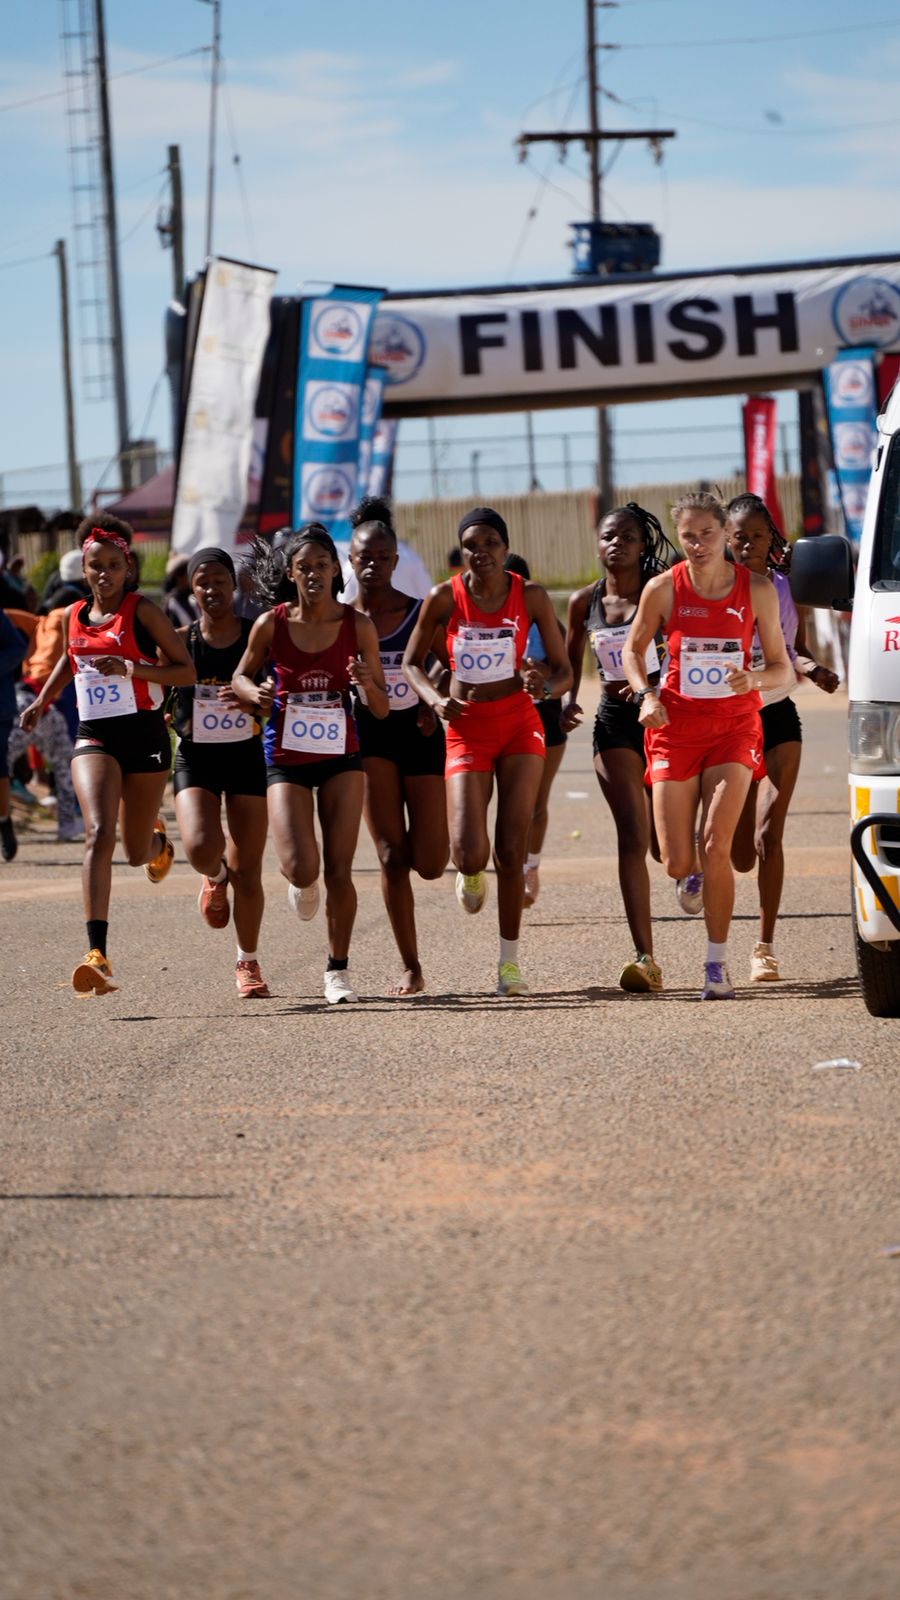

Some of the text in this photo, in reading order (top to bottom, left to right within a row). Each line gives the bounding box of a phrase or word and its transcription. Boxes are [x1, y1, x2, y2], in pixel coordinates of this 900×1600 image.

[458, 292, 800, 376] FINISH
[460, 653, 505, 670] 007
[86, 684, 120, 705] 193
[385, 682, 409, 699] 20
[203, 713, 247, 730] 066
[292, 720, 339, 740] 008
